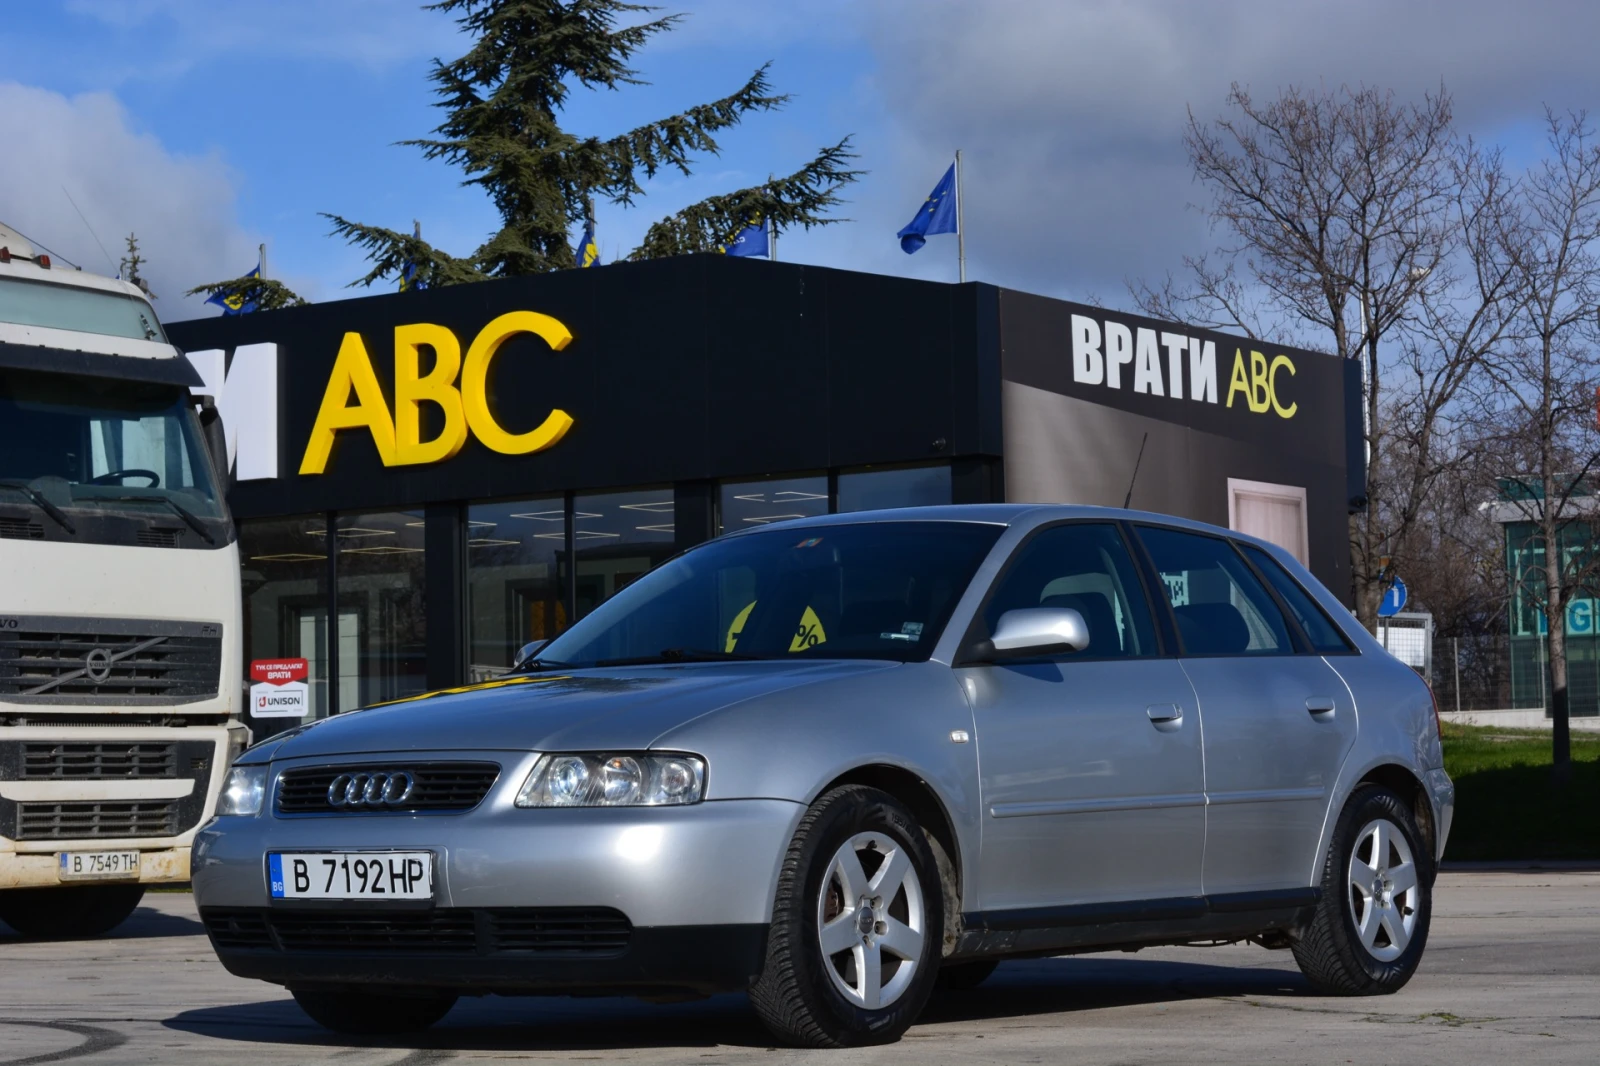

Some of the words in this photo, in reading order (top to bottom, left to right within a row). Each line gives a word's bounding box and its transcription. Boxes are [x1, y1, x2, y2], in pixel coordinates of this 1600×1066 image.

[1071, 314, 1218, 404] ВРАТИ
[1226, 348, 1298, 419] ABC
[298, 310, 574, 475] ABC
[267, 671, 291, 679] ВРАТИ
[267, 697, 300, 706] UNISON
[74, 855, 82, 873] B
[293, 859, 310, 893] B
[273, 881, 283, 892] BG
